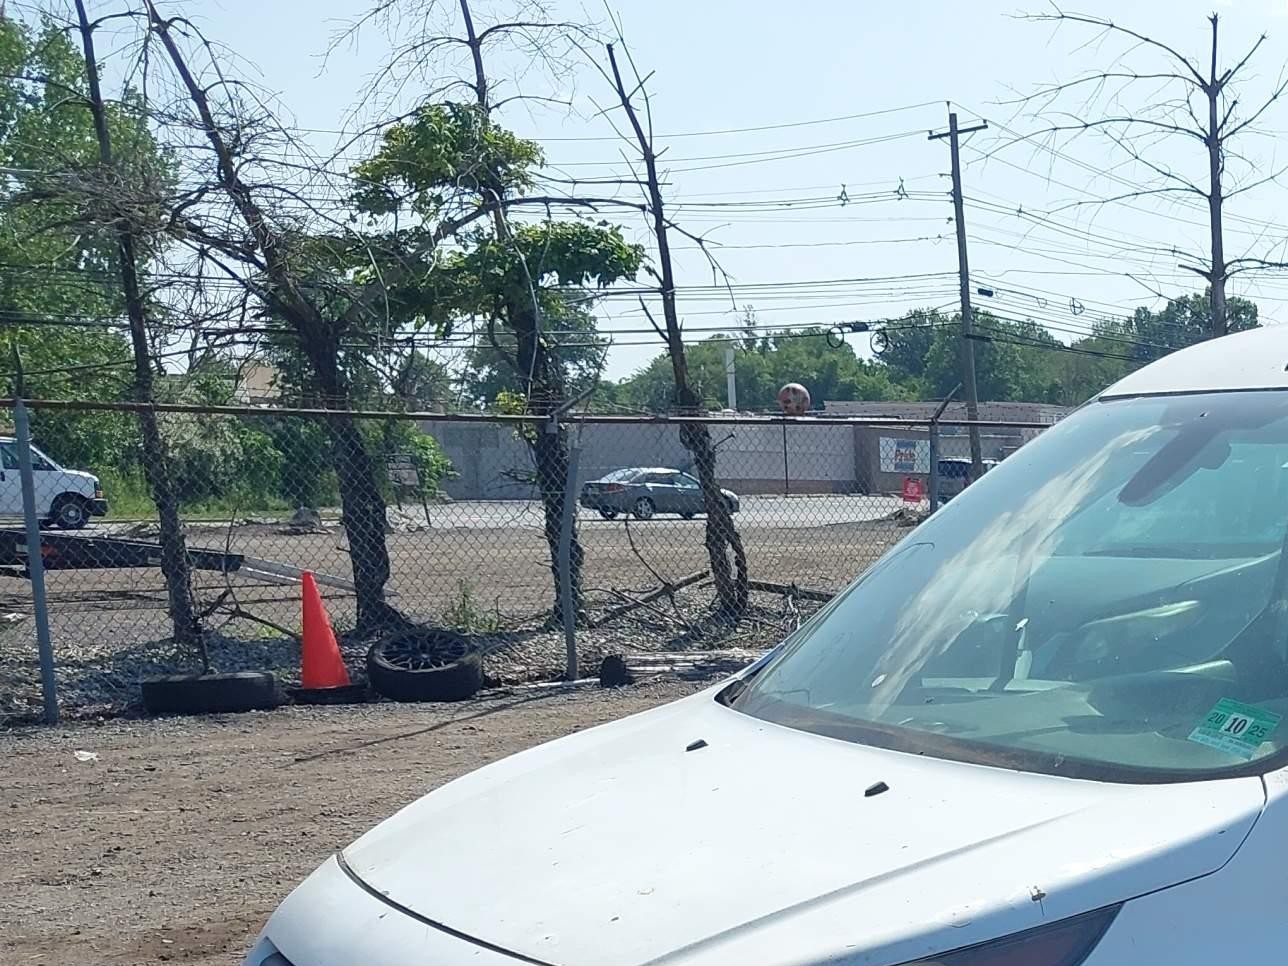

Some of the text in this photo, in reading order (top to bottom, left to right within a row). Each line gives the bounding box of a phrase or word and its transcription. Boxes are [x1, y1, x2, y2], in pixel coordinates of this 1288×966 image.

[1208, 712, 1268, 738] 20 10 25
